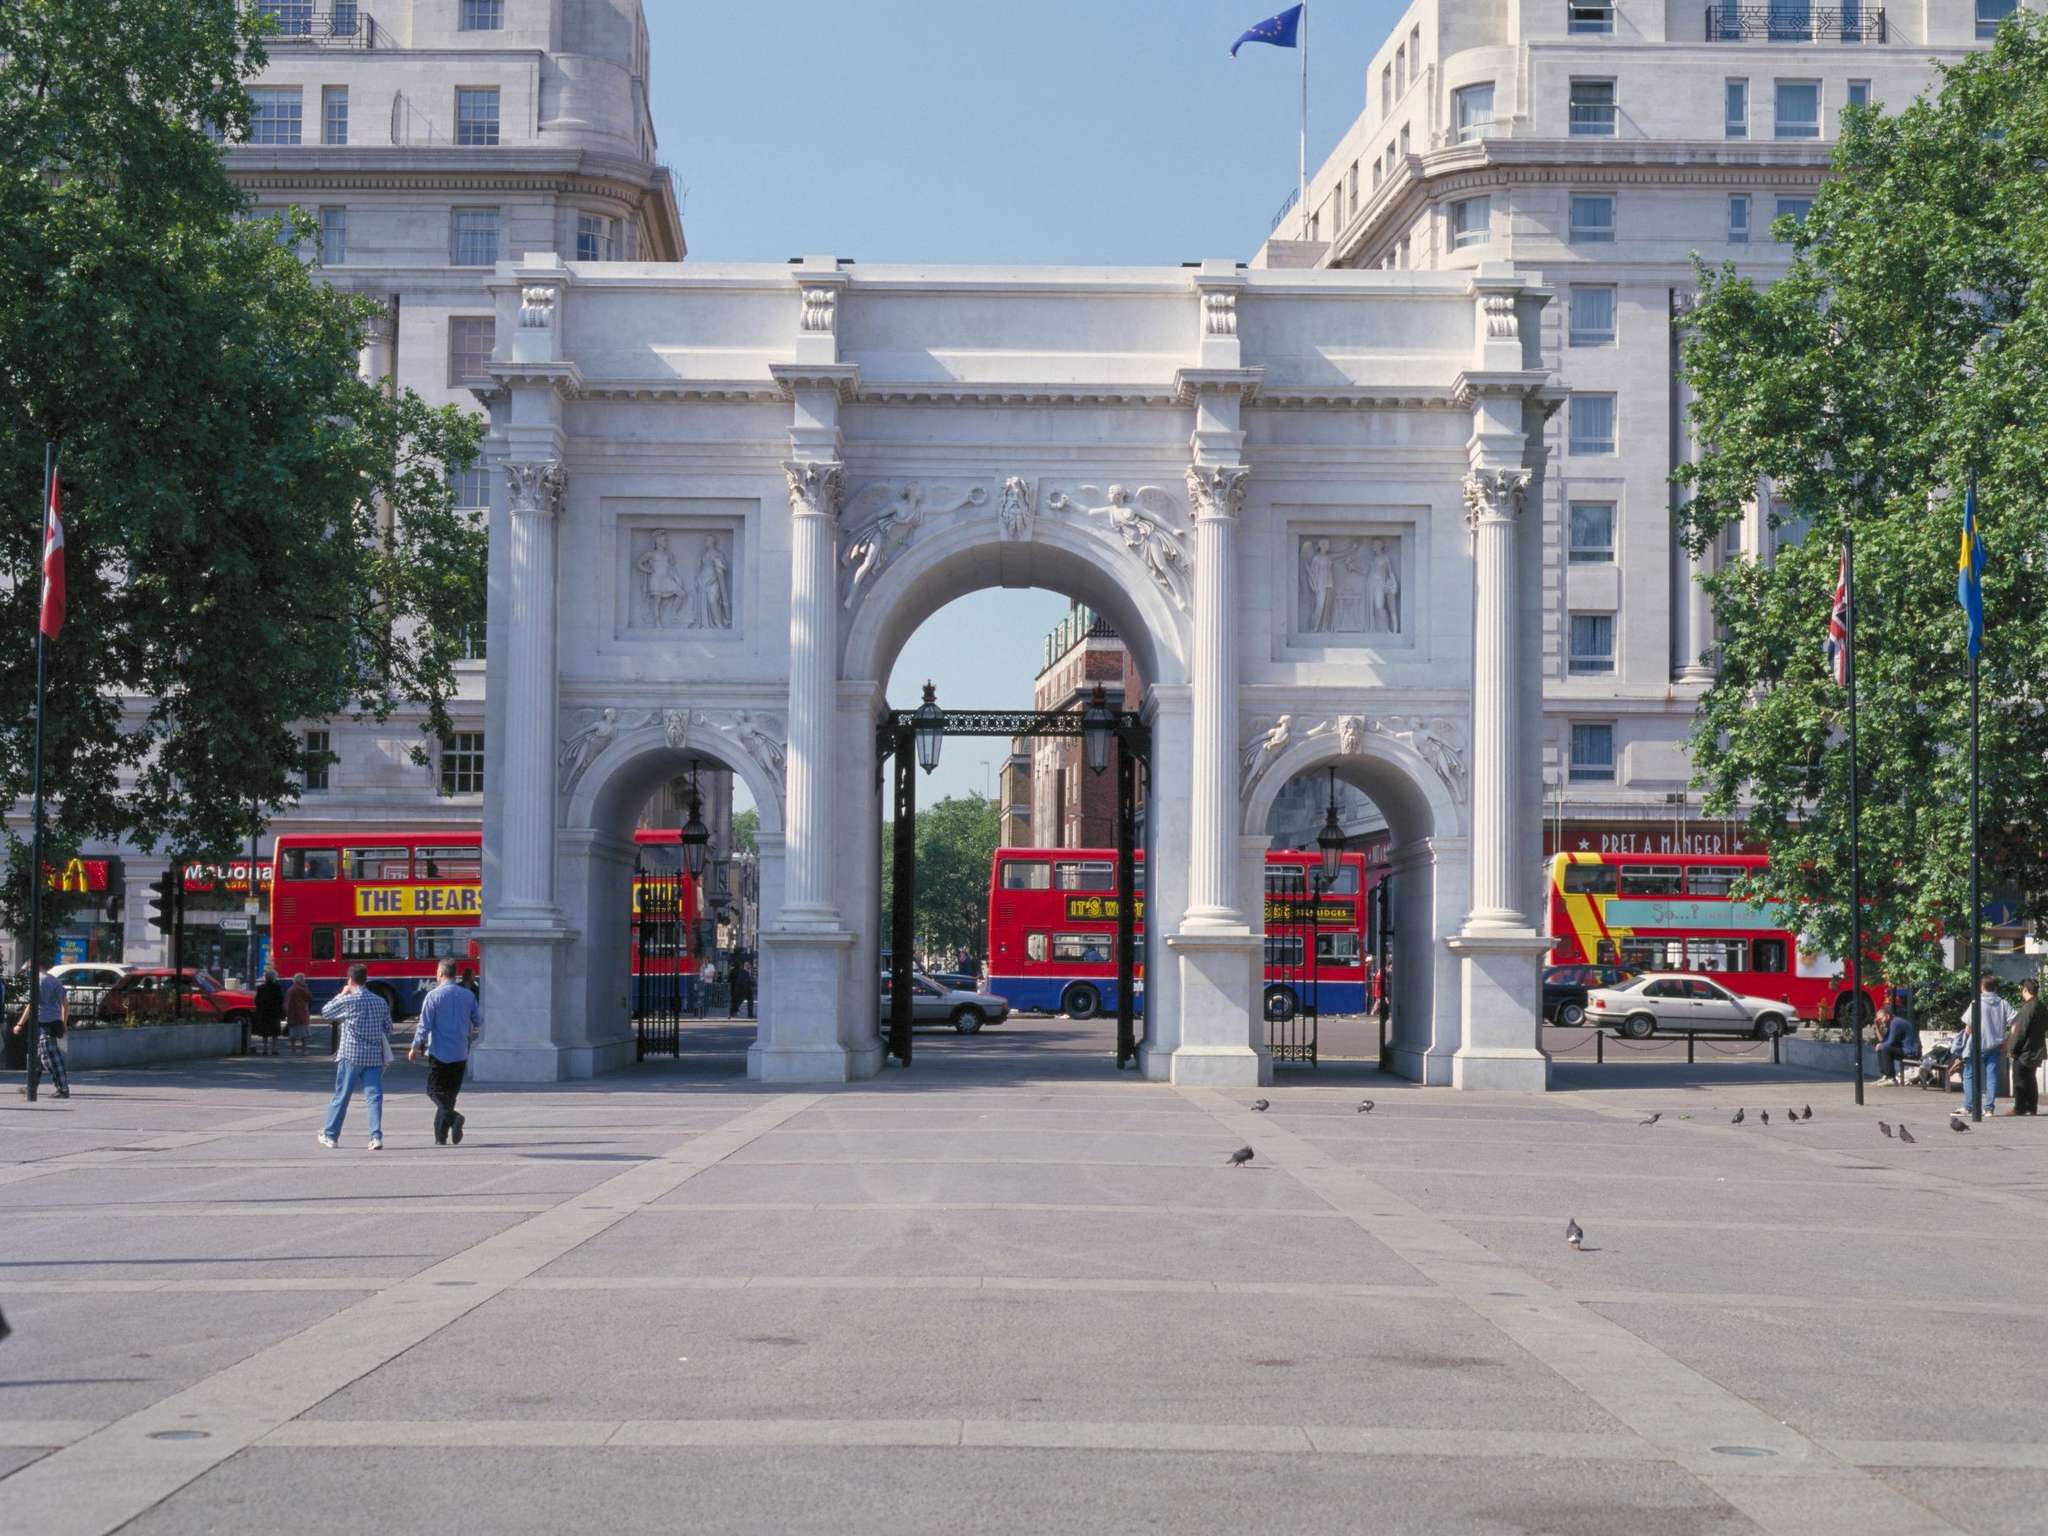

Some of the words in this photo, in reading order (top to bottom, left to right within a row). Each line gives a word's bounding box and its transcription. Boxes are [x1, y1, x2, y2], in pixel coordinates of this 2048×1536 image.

[1601, 834, 1636, 854] PRET
[1644, 835, 1652, 854] A
[1661, 834, 1721, 855] MANGER
[360, 889, 402, 912] THE
[1071, 898, 1101, 918] IT'S
